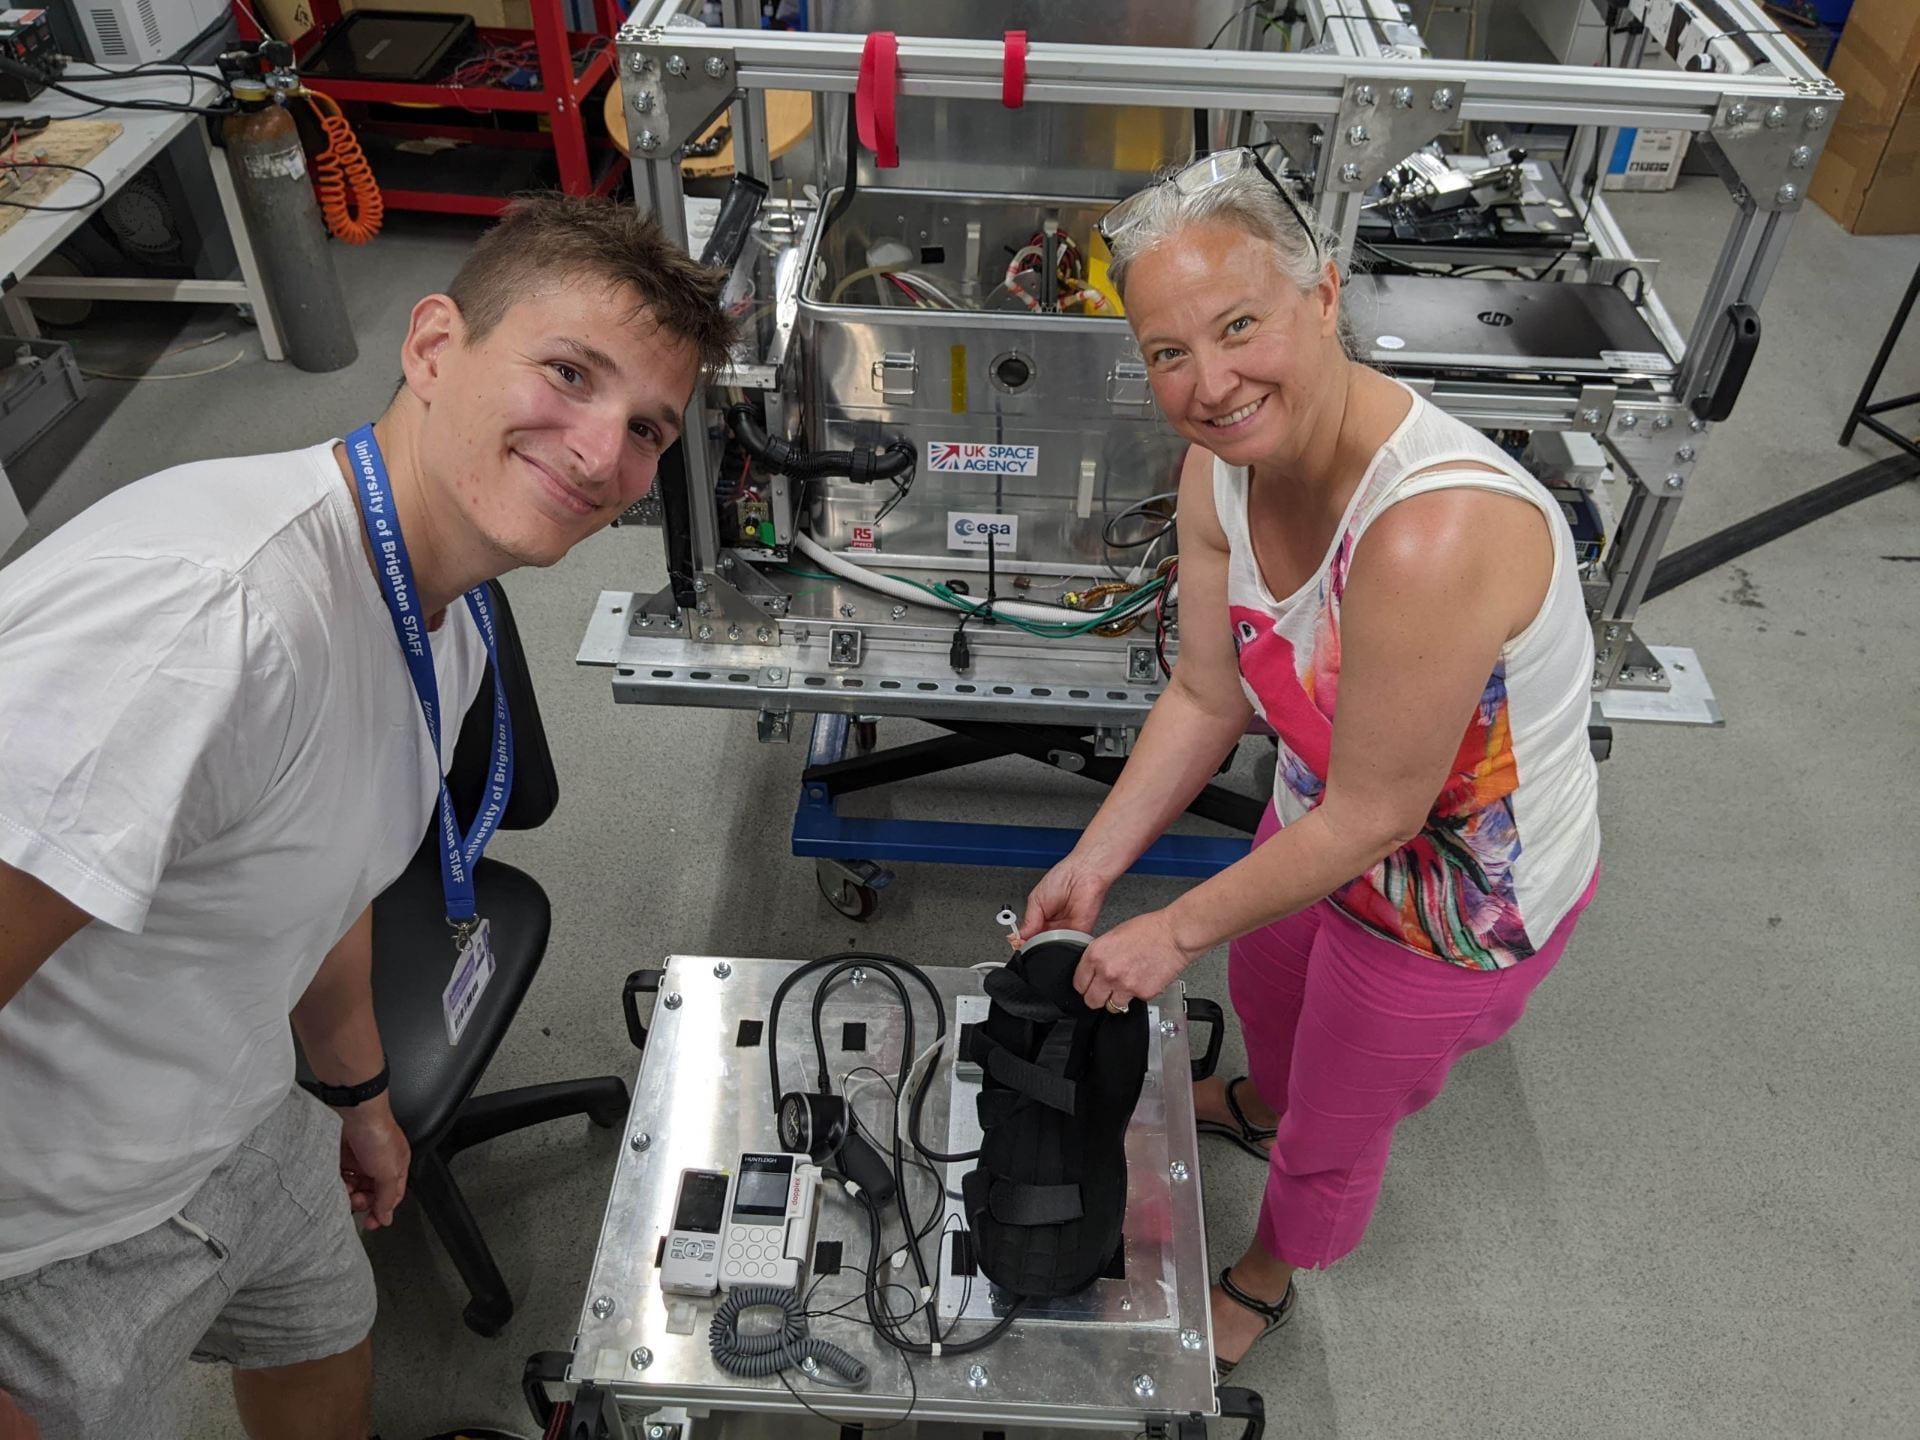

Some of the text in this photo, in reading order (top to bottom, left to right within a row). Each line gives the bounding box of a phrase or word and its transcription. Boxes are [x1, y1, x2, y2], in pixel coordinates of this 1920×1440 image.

[964, 446, 1035, 460] UK SPACE
[964, 460, 1028, 473] AGENCY
[854, 528, 871, 539] RS
[977, 523, 1011, 535] esa
[355, 440, 424, 657] University of Brighton STAFF
[494, 724, 509, 781] Brighton
[492, 785, 504, 801] of
[449, 849, 465, 884] STAFF
[744, 1156, 778, 1164] HUNTLEIGH
